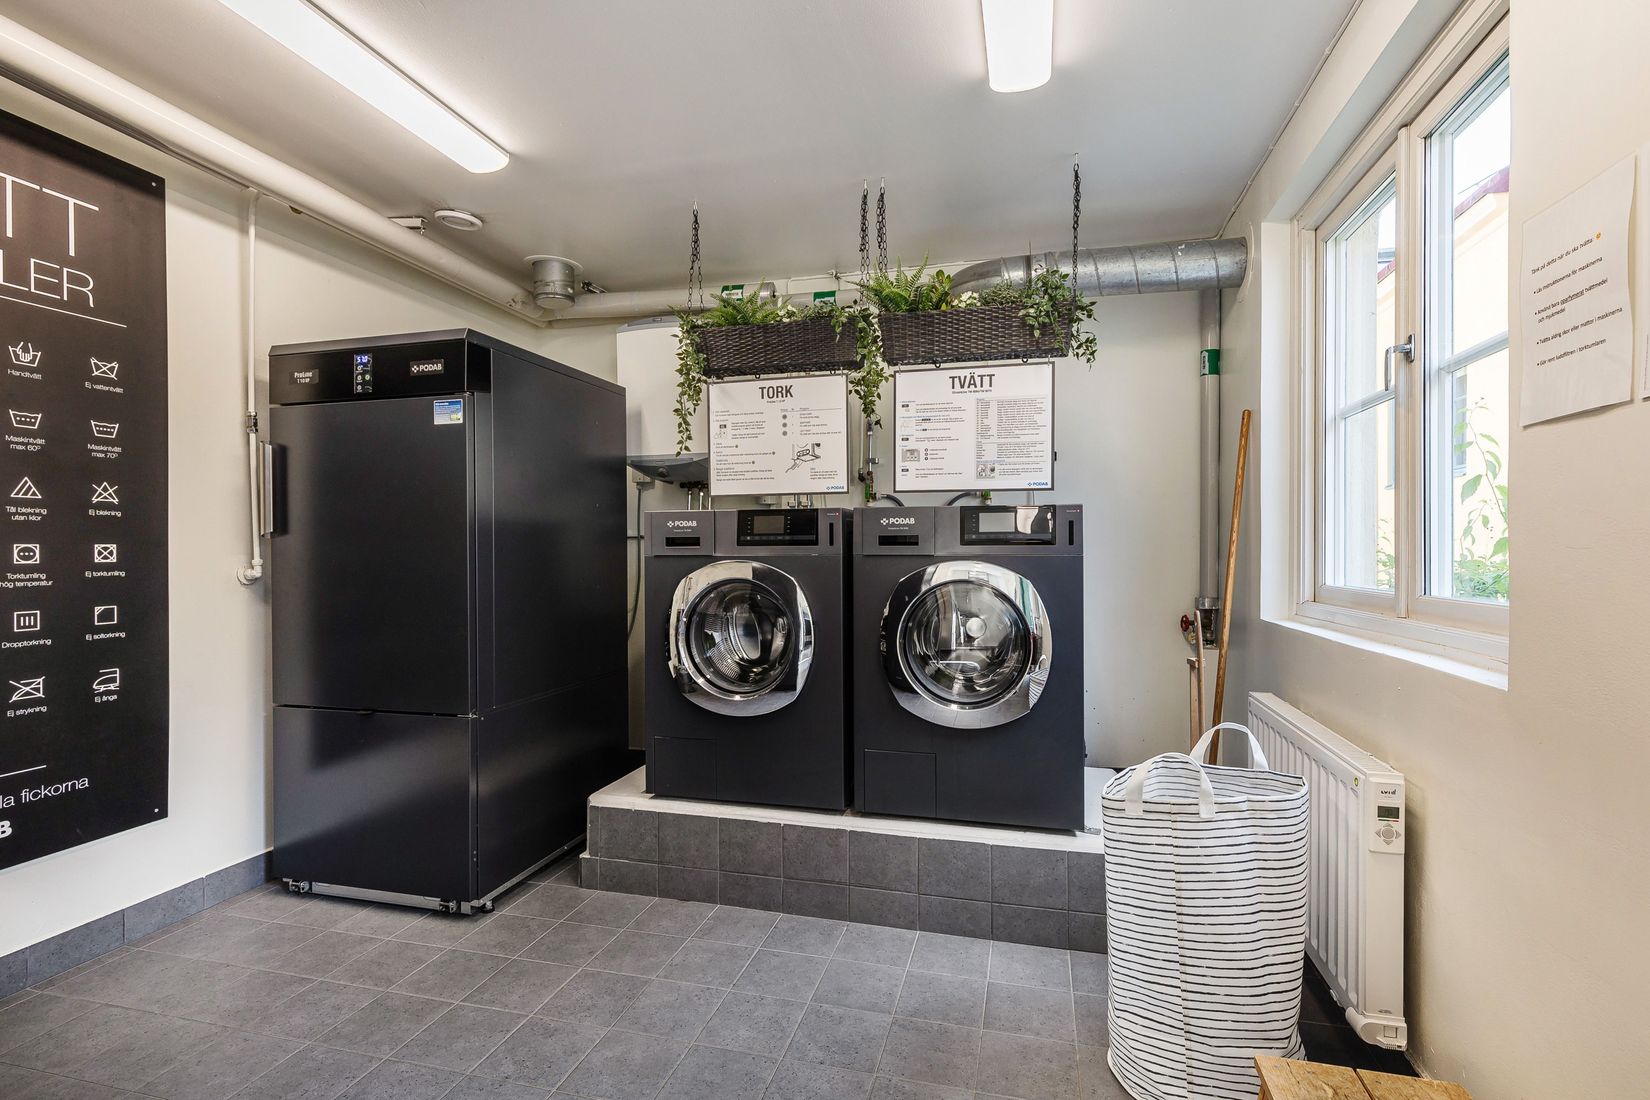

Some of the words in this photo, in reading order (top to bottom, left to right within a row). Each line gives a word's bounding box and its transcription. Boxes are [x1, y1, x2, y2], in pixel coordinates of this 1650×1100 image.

[1578, 256, 1603, 273] maskinerna
[1571, 324, 1580, 333] eller
[1580, 318, 1595, 329] mattor
[1597, 307, 1623, 321] maskinerna
[1578, 338, 1607, 353] torktumlaren
[419, 363, 442, 373] PODAB
[7, 368, 42, 380] Handtvätt
[949, 372, 995, 389] TVÄTT
[85, 381, 92, 389] Ej
[92, 384, 124, 394] vattentvätt
[758, 385, 793, 400] TORK
[5, 435, 46, 445] Maskintvätt
[87, 443, 122, 453] Maskintvätt
[17, 507, 47, 515] blekning
[96, 509, 122, 517] blekning
[889, 517, 915, 525] PODAB
[15, 580, 53, 588] temperatur
[93, 632, 125, 640] soltorkning
[1, 639, 52, 649] Dropptorkning
[102, 694, 118, 702] ånga
[7, 710, 14, 718] Ej
[15, 705, 47, 716] strykning
[20, 777, 89, 803] fickorna
